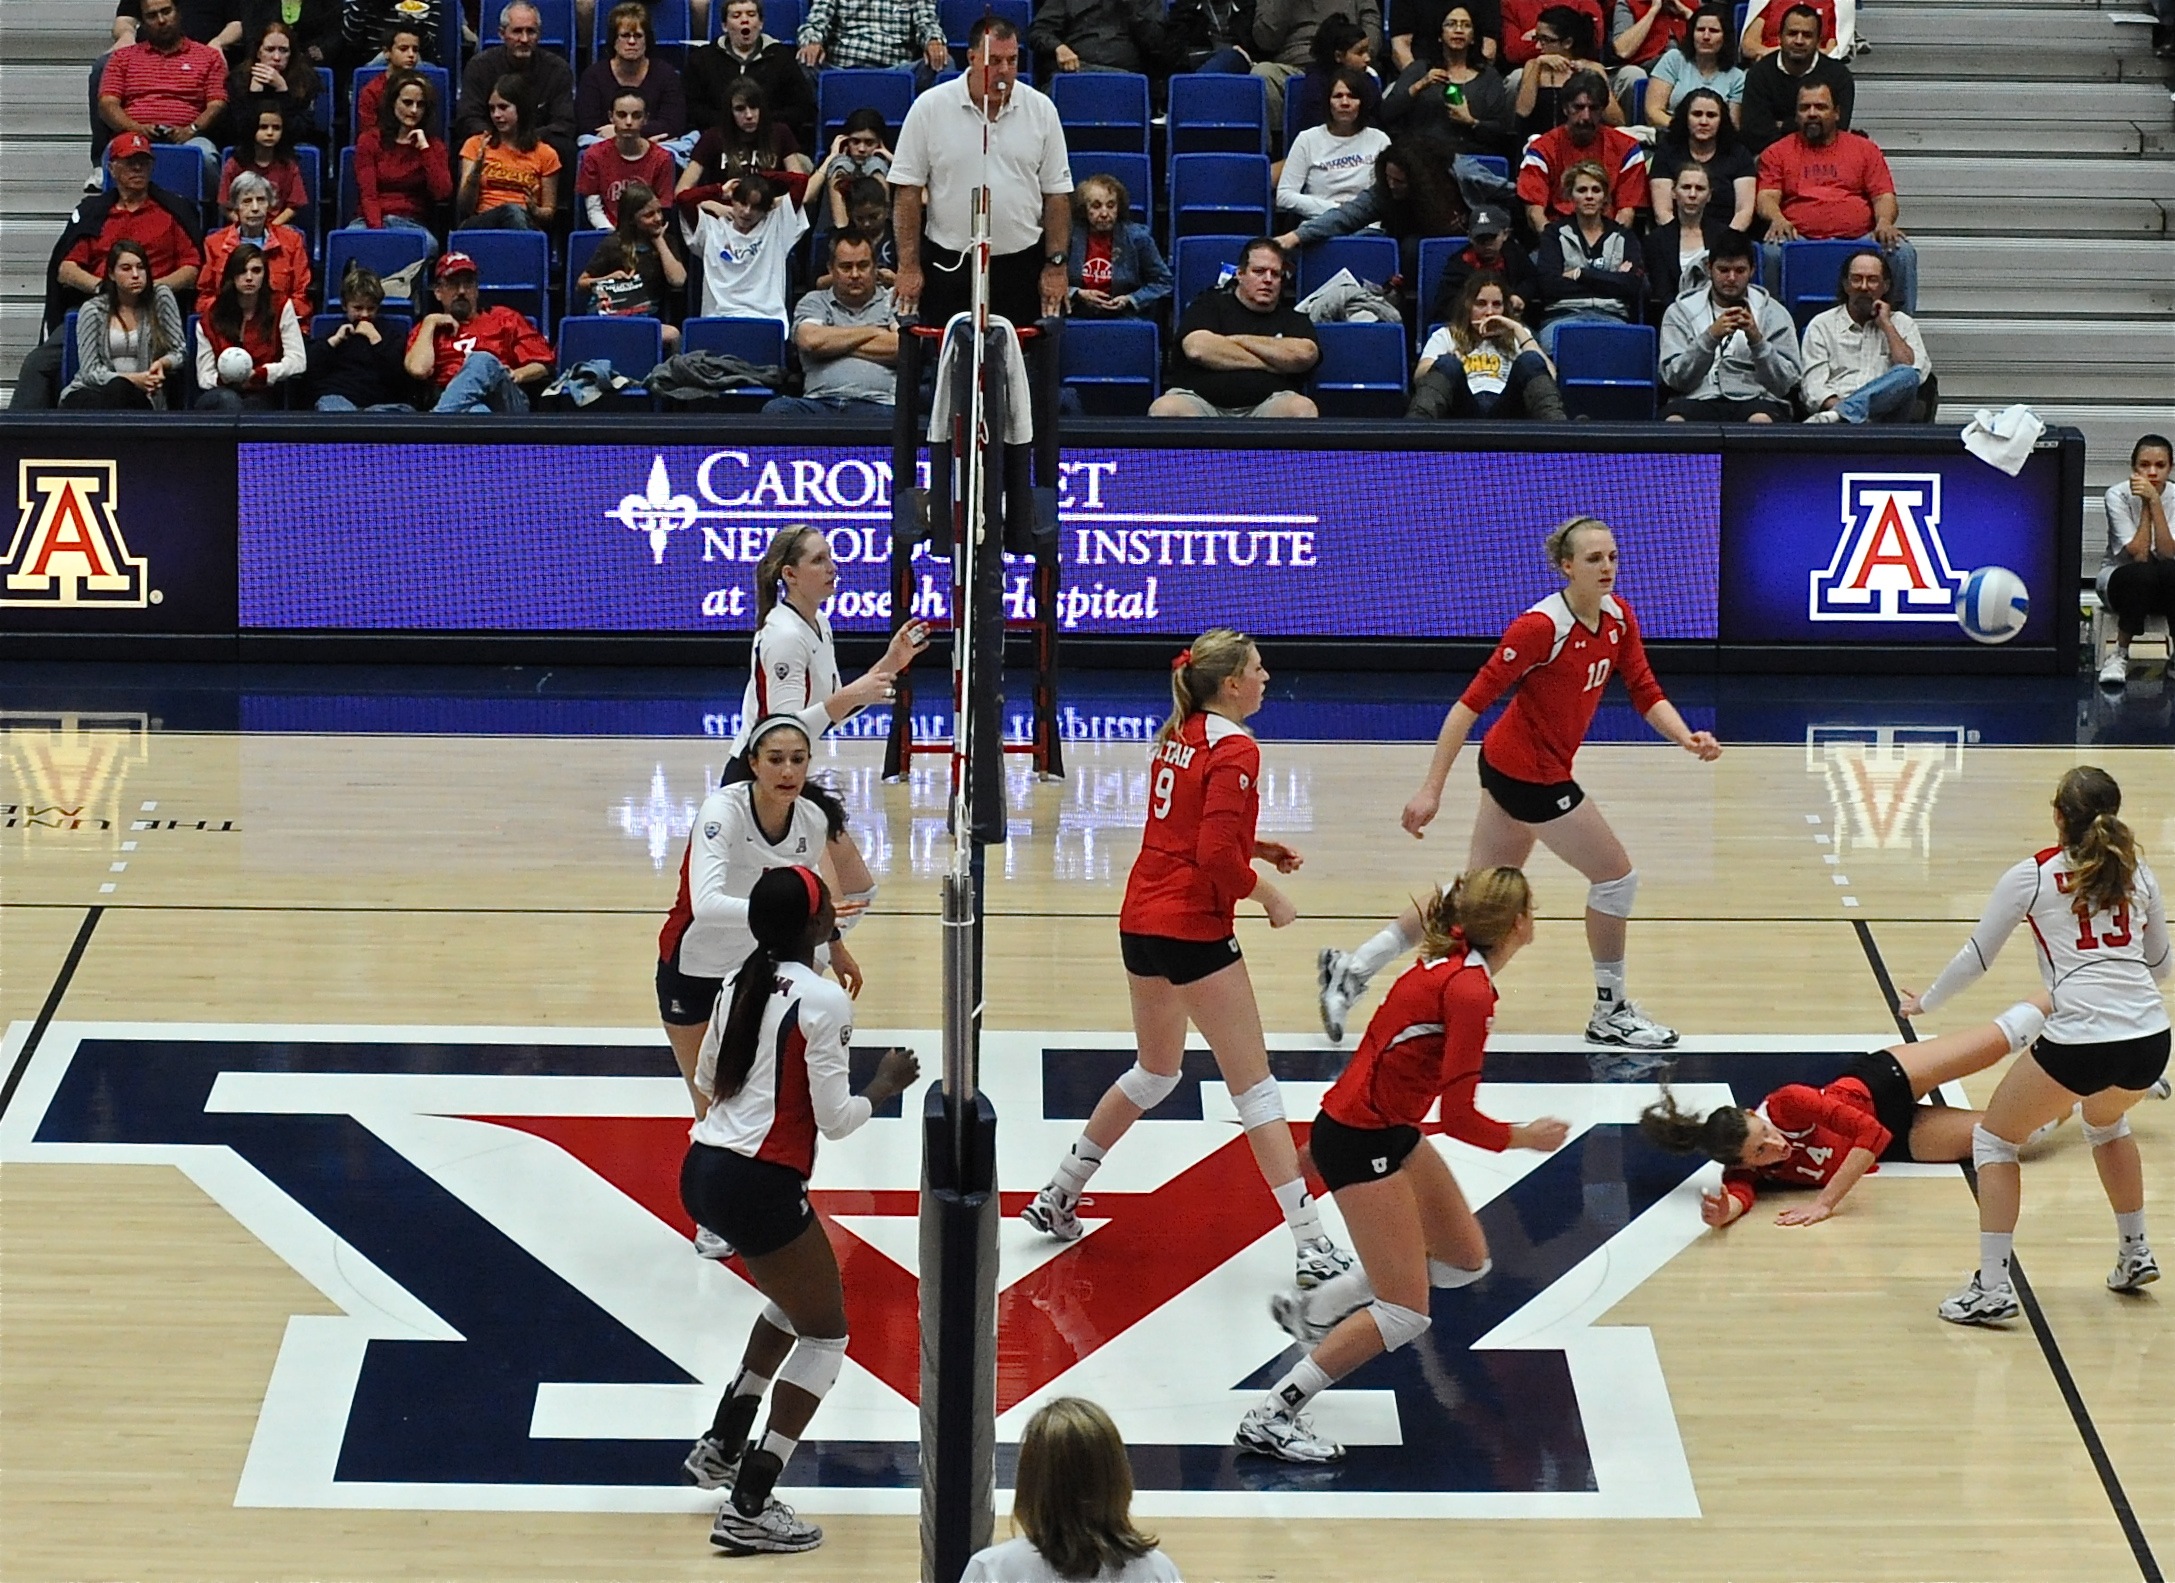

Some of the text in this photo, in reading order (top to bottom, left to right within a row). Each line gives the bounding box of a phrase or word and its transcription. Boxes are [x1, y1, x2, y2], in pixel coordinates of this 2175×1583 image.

[697, 450, 1118, 509] CAROET
[0, 459, 149, 609] A
[1075, 529, 1318, 567] INSTITUTE
[1809, 472, 1972, 623] A
[701, 584, 746, 618] at
[1582, 657, 1612, 692] 10
[1153, 767, 1176, 820] 9
[2071, 896, 2132, 950] 13
[1795, 1145, 1834, 1181] 14
